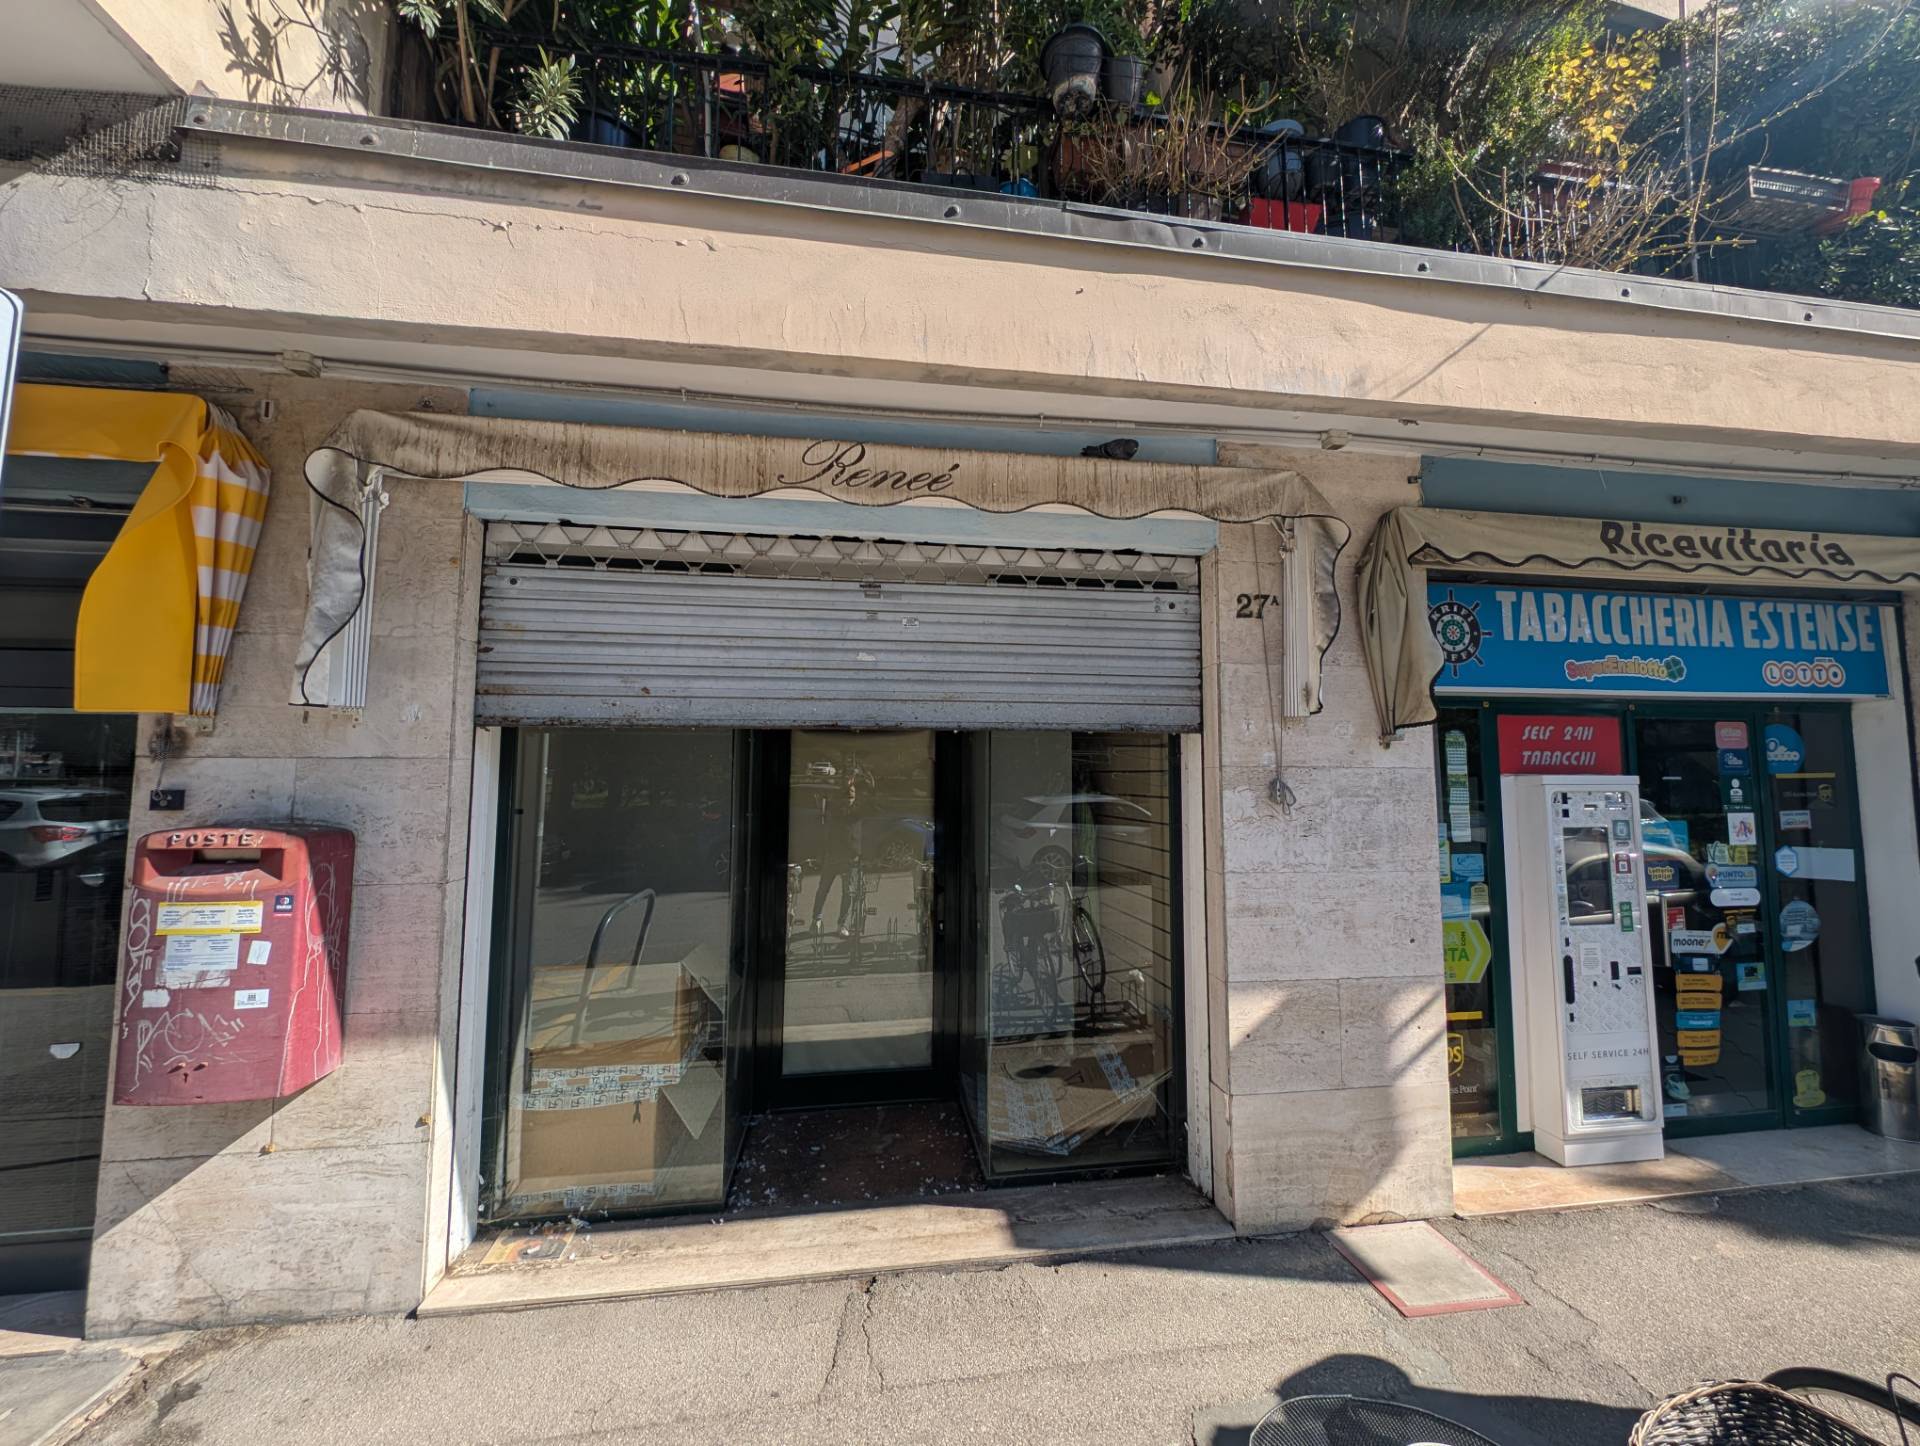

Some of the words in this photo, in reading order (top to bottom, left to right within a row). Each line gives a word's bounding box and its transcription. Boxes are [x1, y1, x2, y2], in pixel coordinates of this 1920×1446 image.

[1600, 521, 1855, 566] Ricevitoria
[1496, 591, 1735, 648] TABACCHERIA
[1739, 602, 1877, 652] ESTENSE
[1765, 664, 1842, 685] LOTTO
[1522, 725, 1555, 740] SELF
[1563, 726, 1594, 741] 24H
[1522, 751, 1597, 766] TABACCHI
[166, 832, 256, 848] POSTE
[1673, 937, 1711, 949] mooney
[1567, 1051, 1588, 1061] SELF
[1591, 1048, 1628, 1059] SERVICE
[1633, 1047, 1649, 1056] 24H
